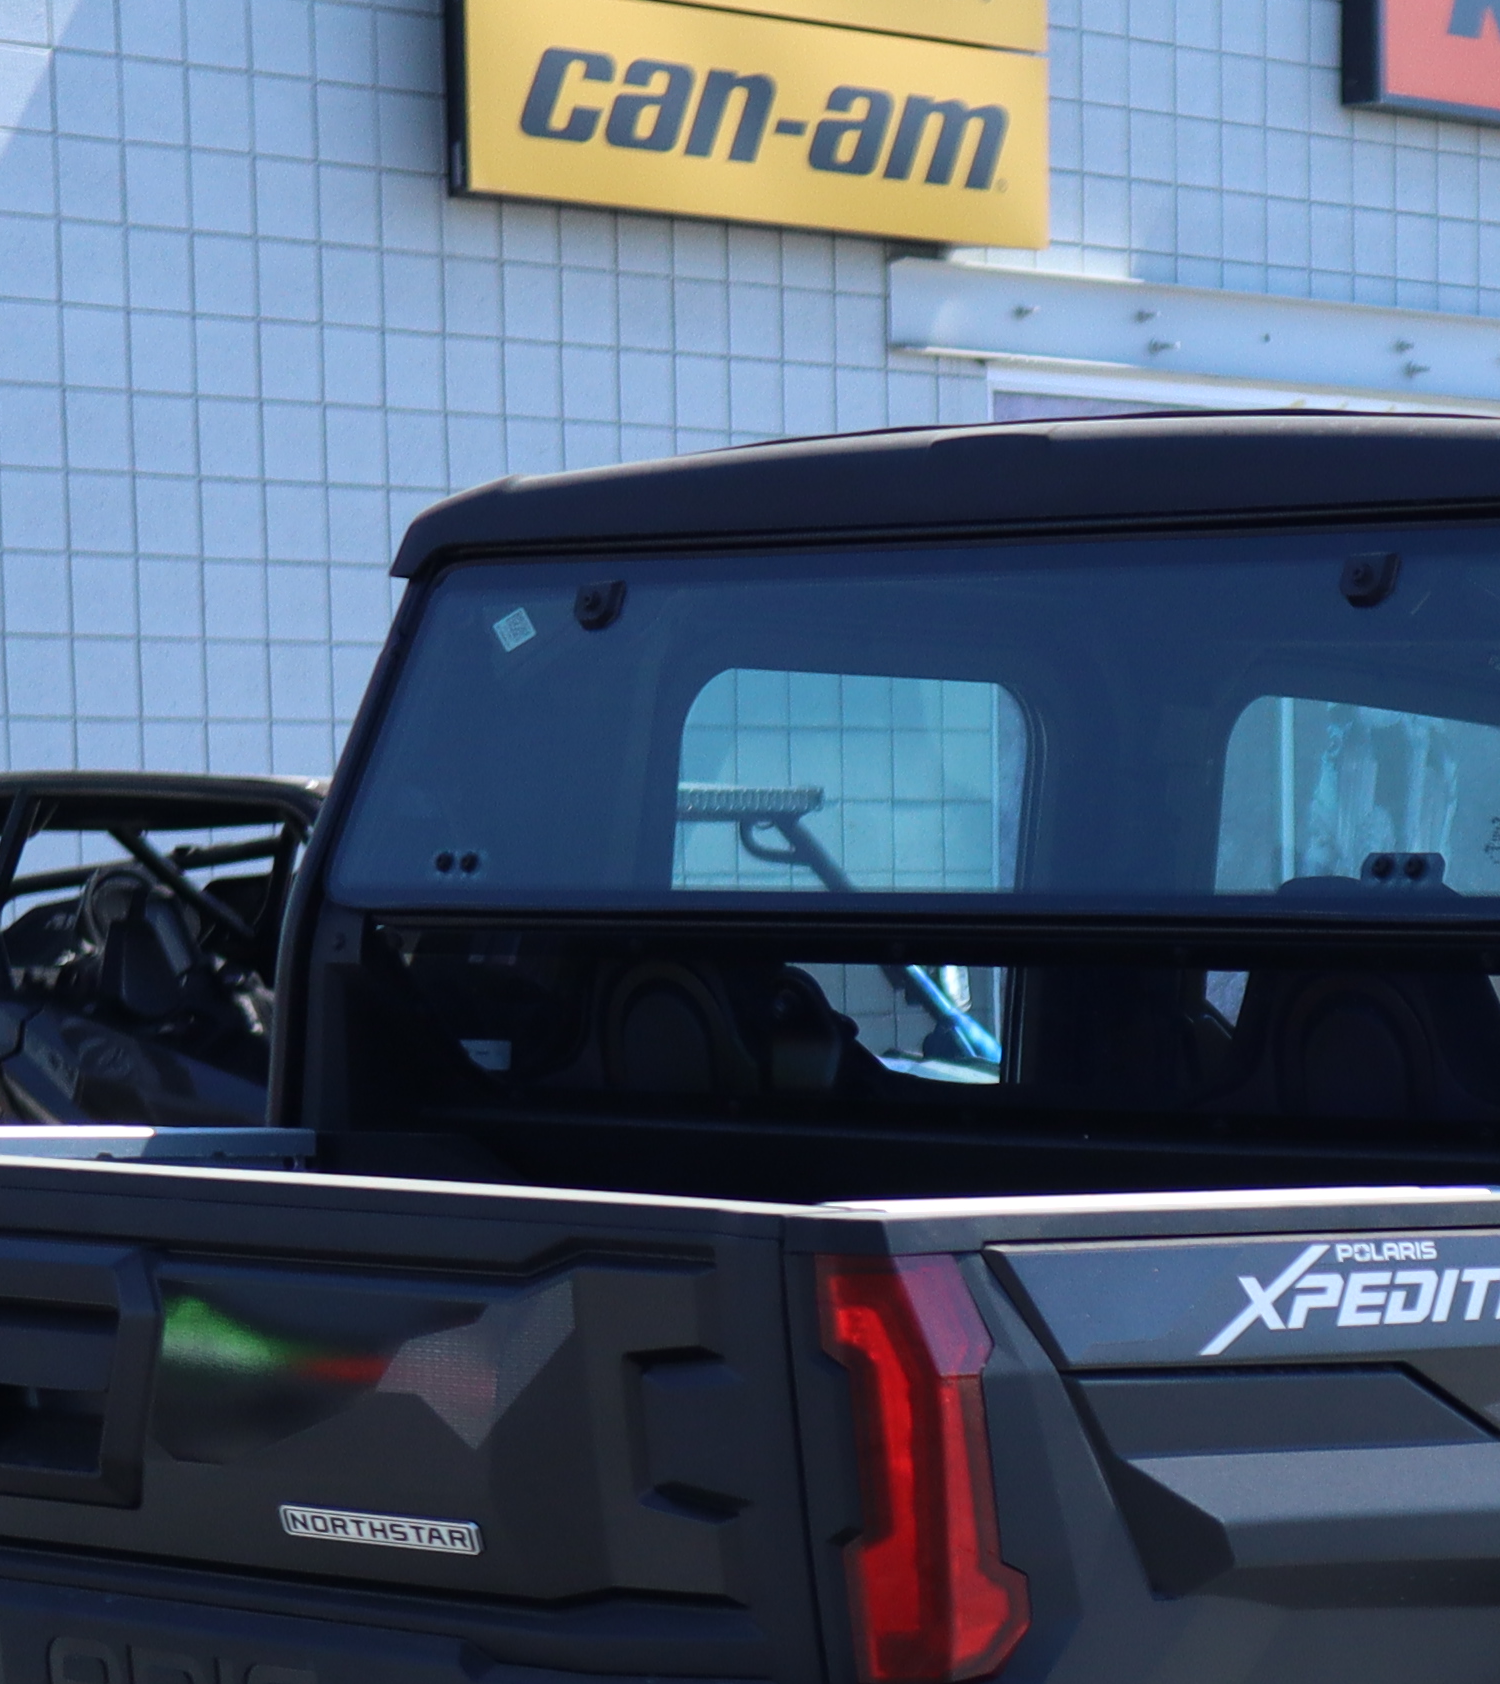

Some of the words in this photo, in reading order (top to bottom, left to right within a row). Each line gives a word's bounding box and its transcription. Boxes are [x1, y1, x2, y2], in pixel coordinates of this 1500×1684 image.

[520, 45, 1010, 191] can-am
[1335, 1240, 1438, 1263] POLARIS
[289, 1512, 469, 1548] NORTHSTAR
